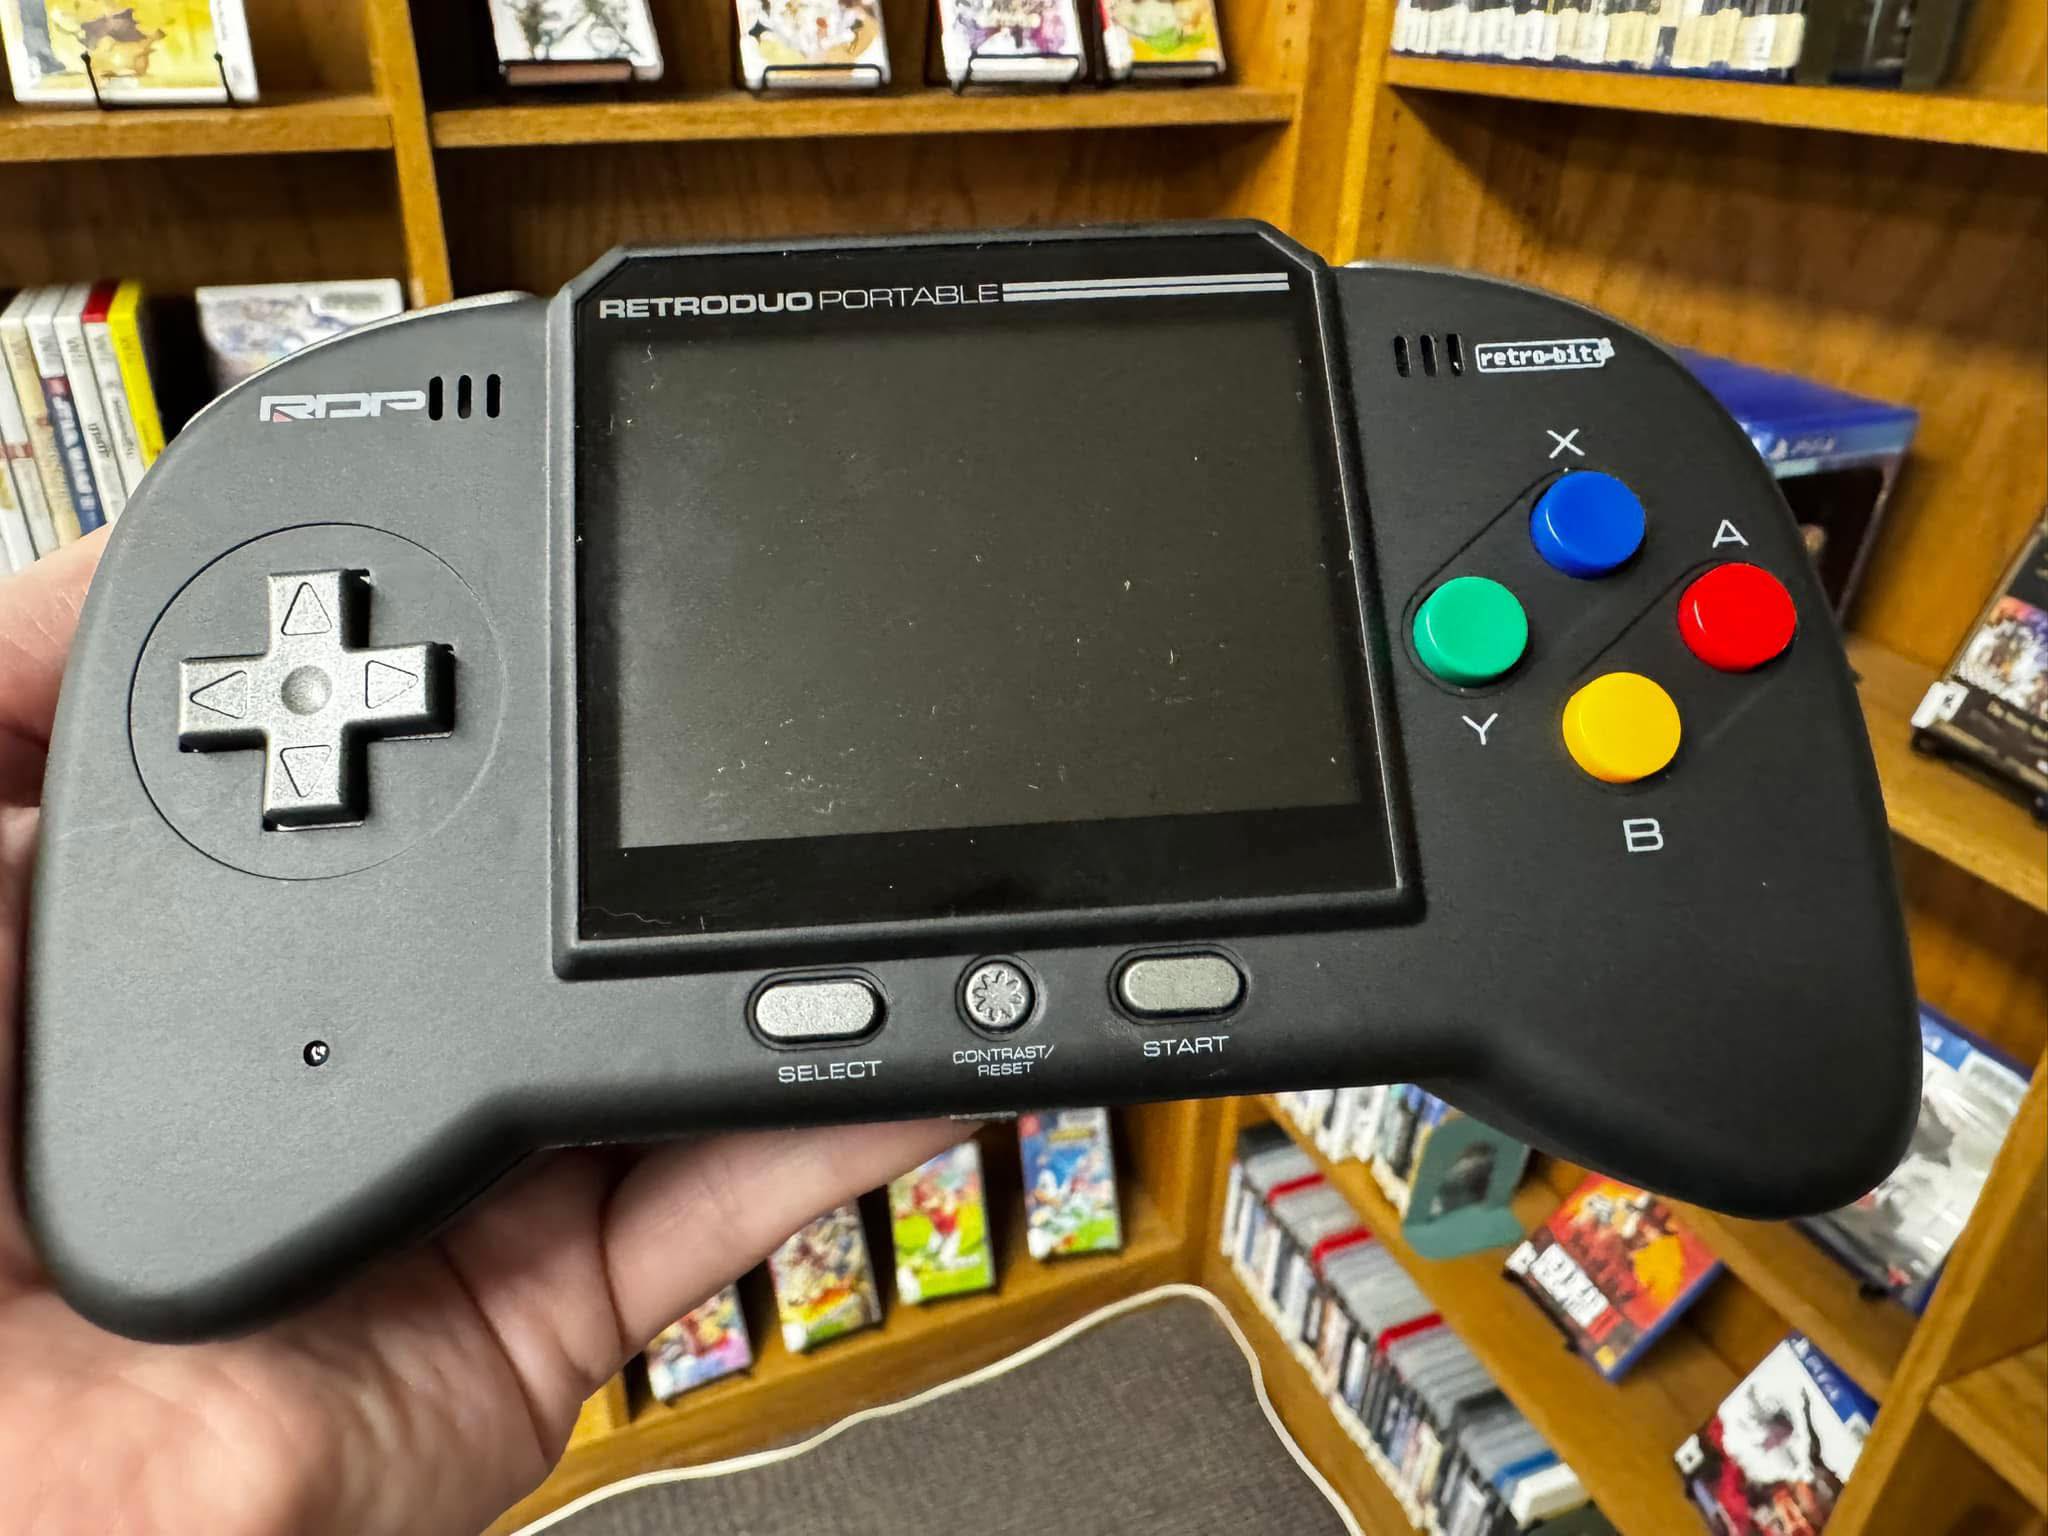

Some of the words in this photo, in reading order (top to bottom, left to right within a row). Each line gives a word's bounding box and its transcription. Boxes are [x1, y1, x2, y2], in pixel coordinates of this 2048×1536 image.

[599, 291, 813, 319] RETRODUO
[819, 283, 1000, 311] PORTABLE
[1547, 429, 1585, 459] X
[1712, 519, 1749, 549] A
[1462, 712, 1499, 746] Y
[1622, 818, 1664, 853] B
[952, 1044, 1055, 1066] CONTRAST/
[1143, 1035, 1230, 1058] START
[778, 1060, 883, 1083] SELECT
[977, 1061, 1034, 1077] RESET
